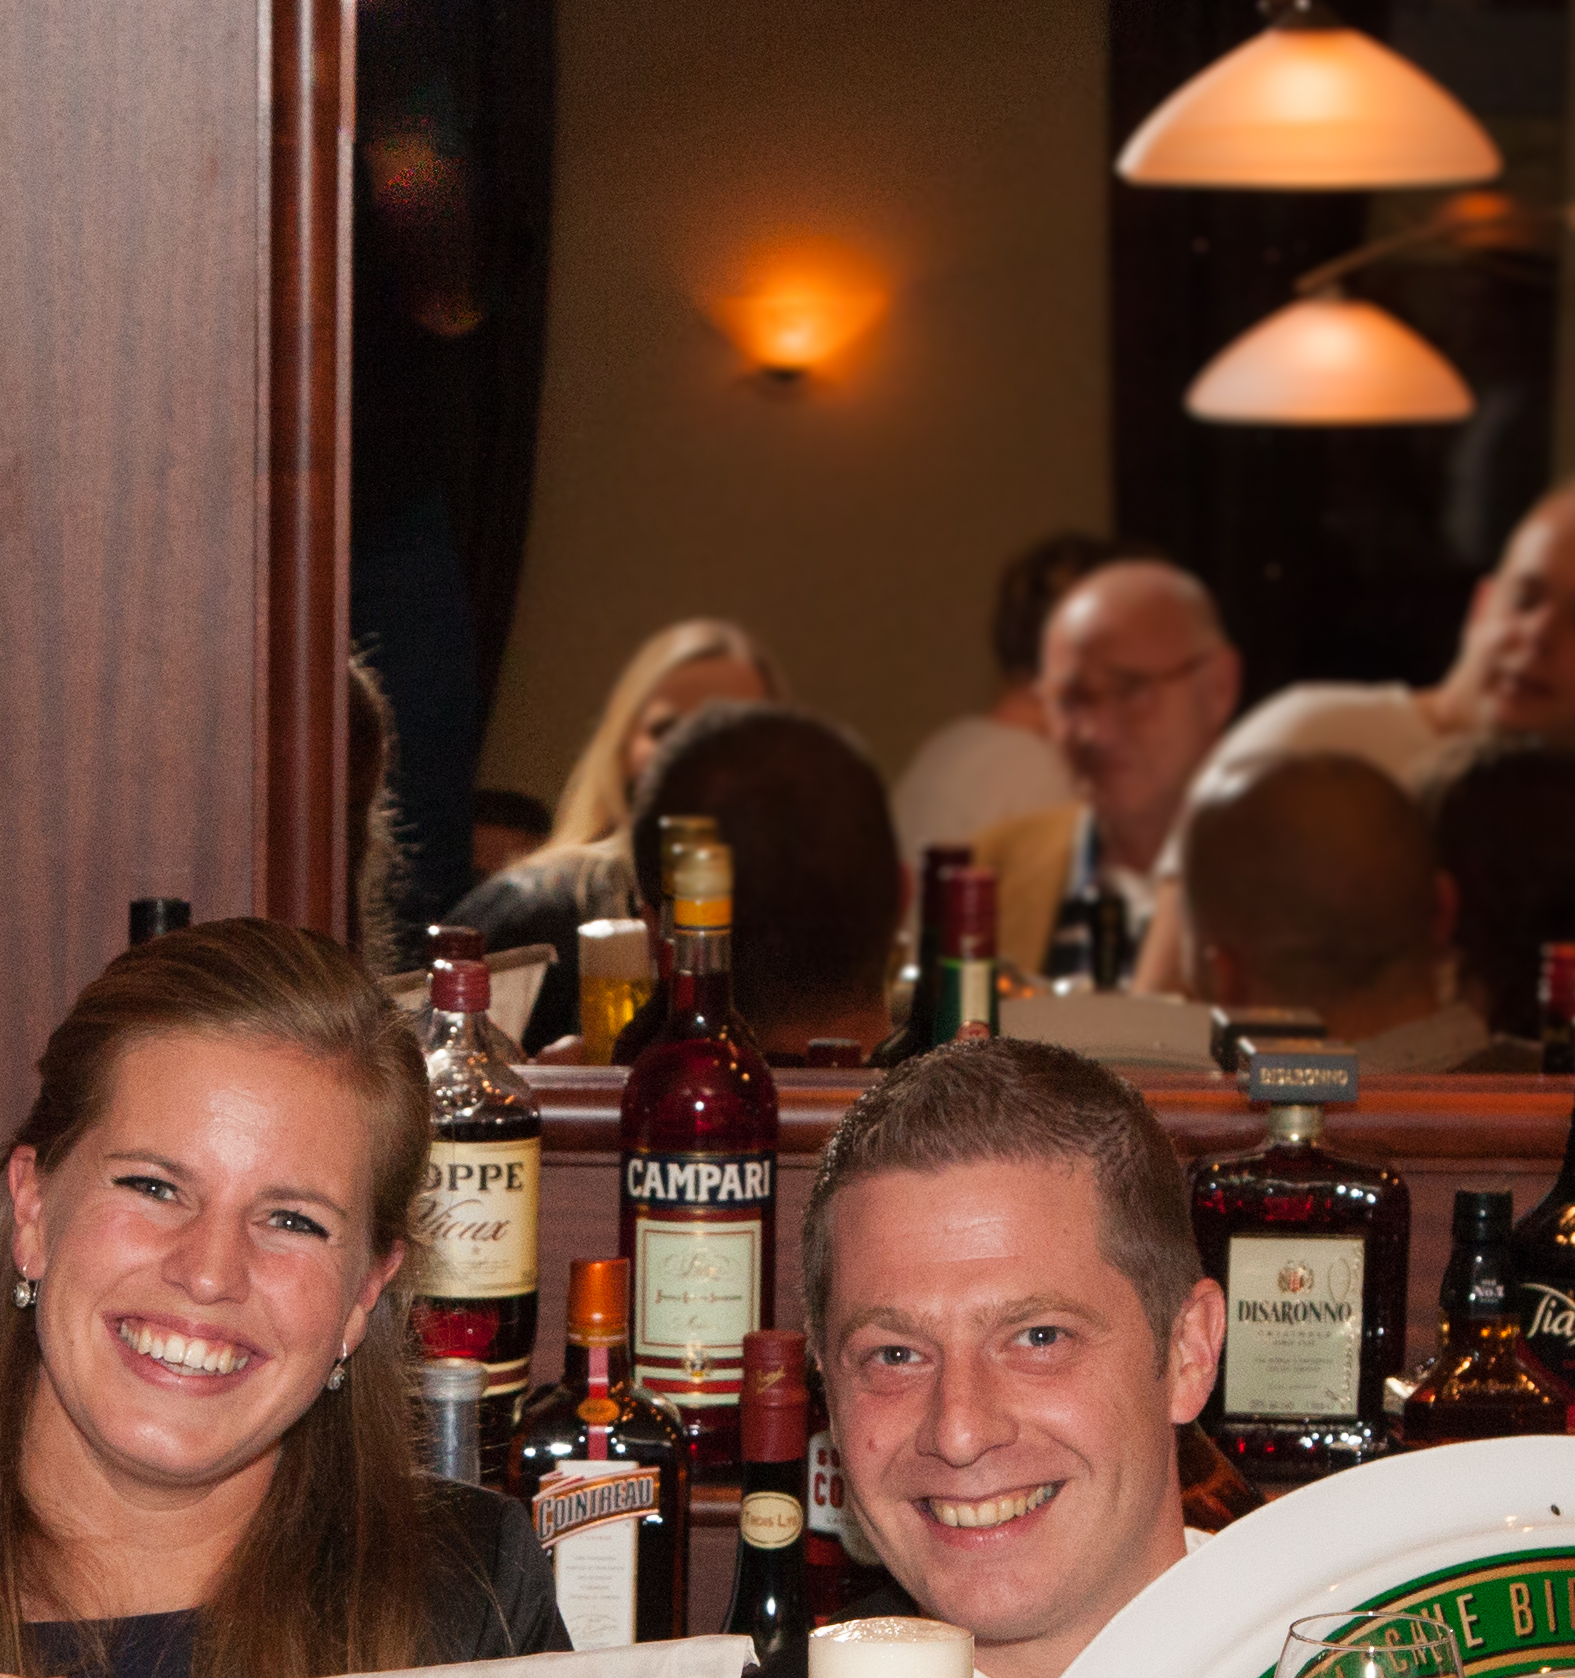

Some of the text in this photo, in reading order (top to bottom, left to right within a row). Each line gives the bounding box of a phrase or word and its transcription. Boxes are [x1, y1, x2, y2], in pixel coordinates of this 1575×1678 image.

[1260, 1067, 1349, 1085] DISARONNO
[627, 1158, 771, 1201] CAMPARI
[1237, 1300, 1353, 1324] DISARONNO
[537, 1476, 655, 1541] COINTREAU
